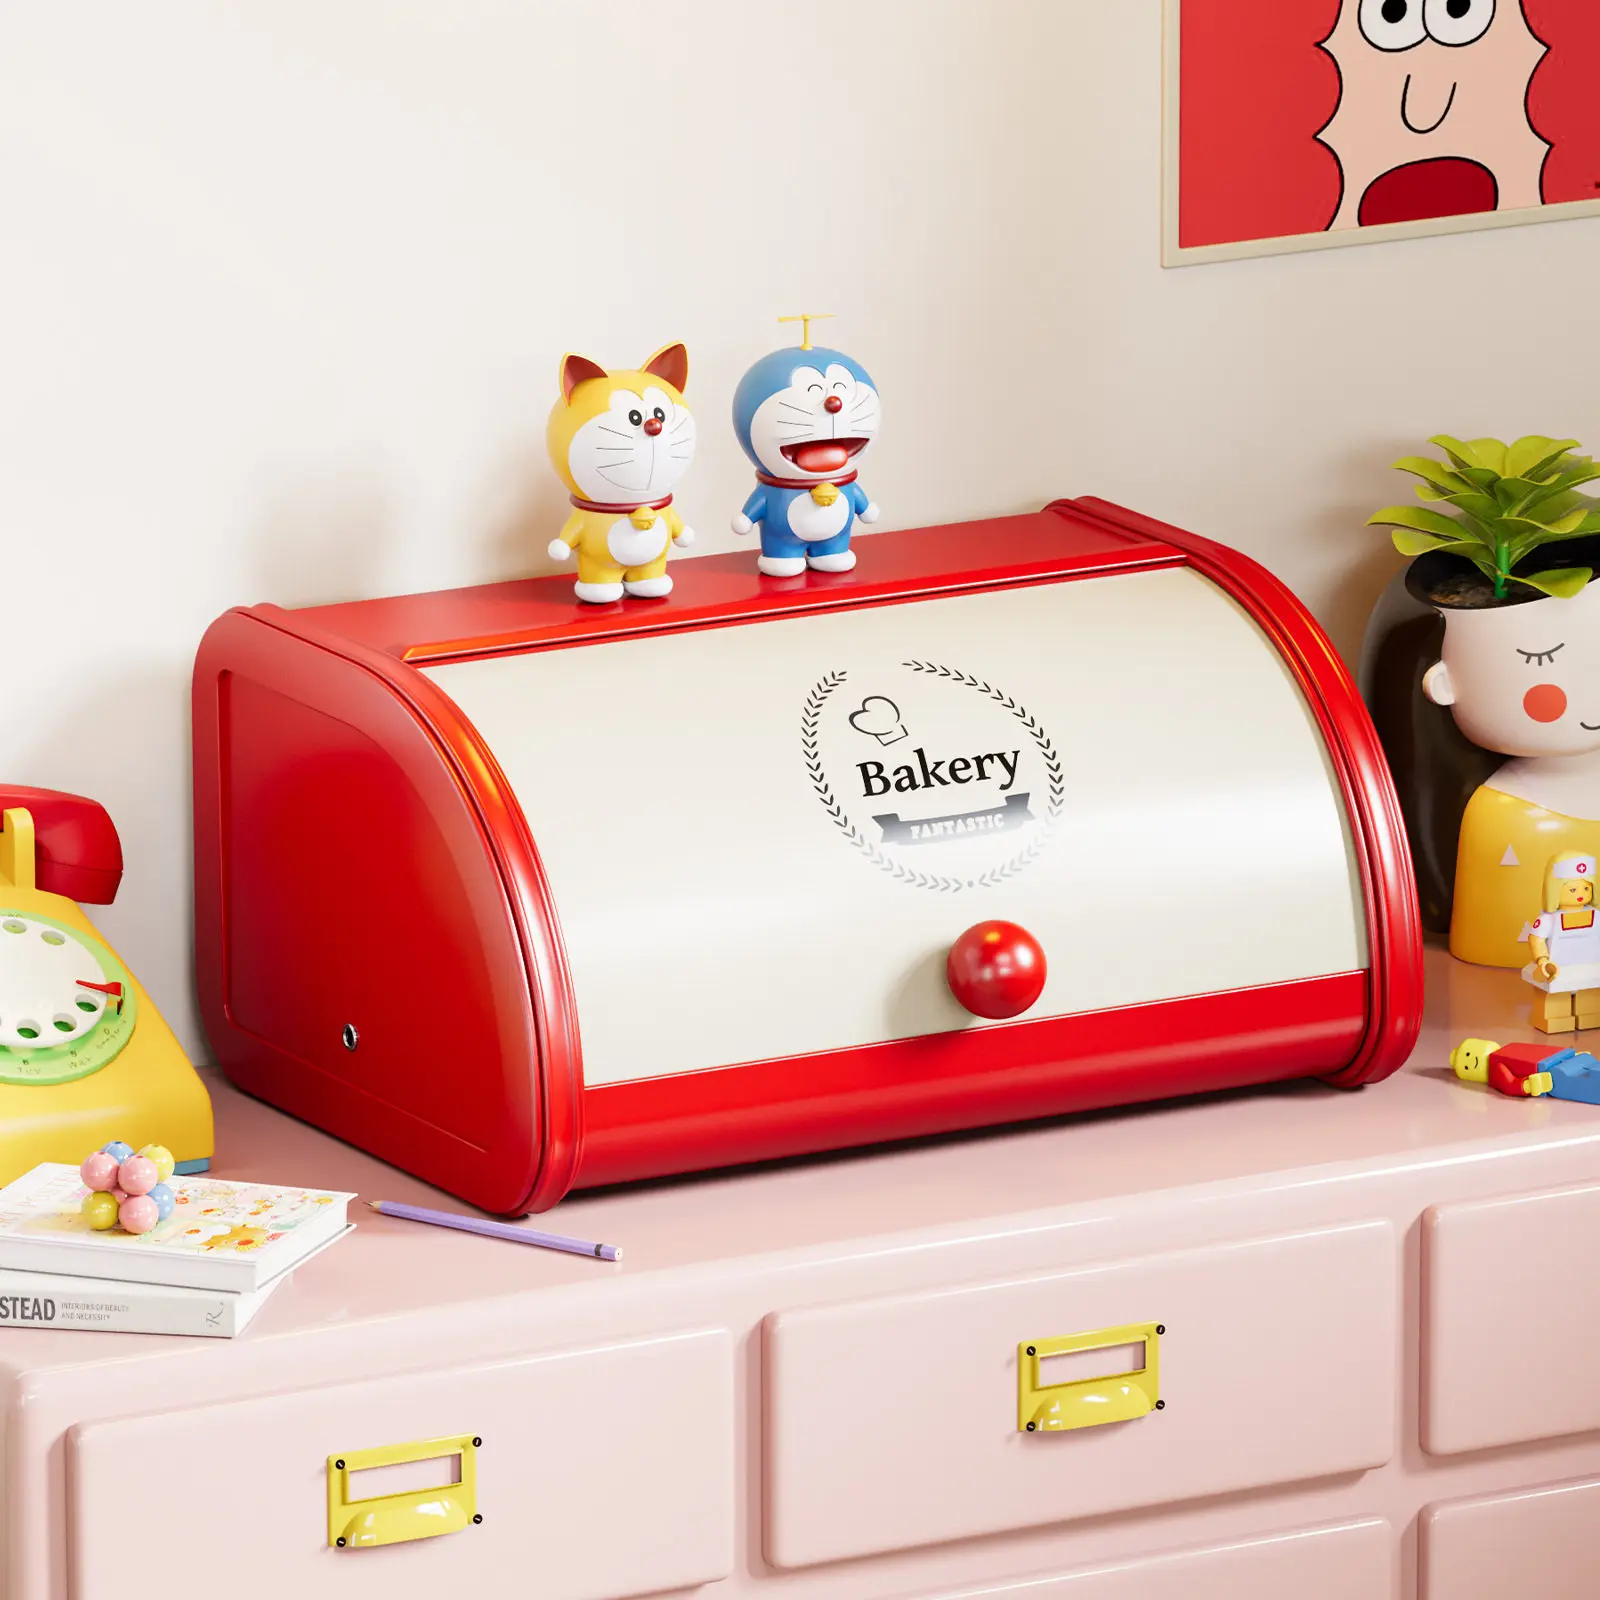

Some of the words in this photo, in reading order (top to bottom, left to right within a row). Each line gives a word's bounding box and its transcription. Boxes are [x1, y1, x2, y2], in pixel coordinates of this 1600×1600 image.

[856, 747, 1021, 797] Bakery
[910, 814, 1005, 840] FANTASTIC
[0, 1296, 56, 1321] STEAD
